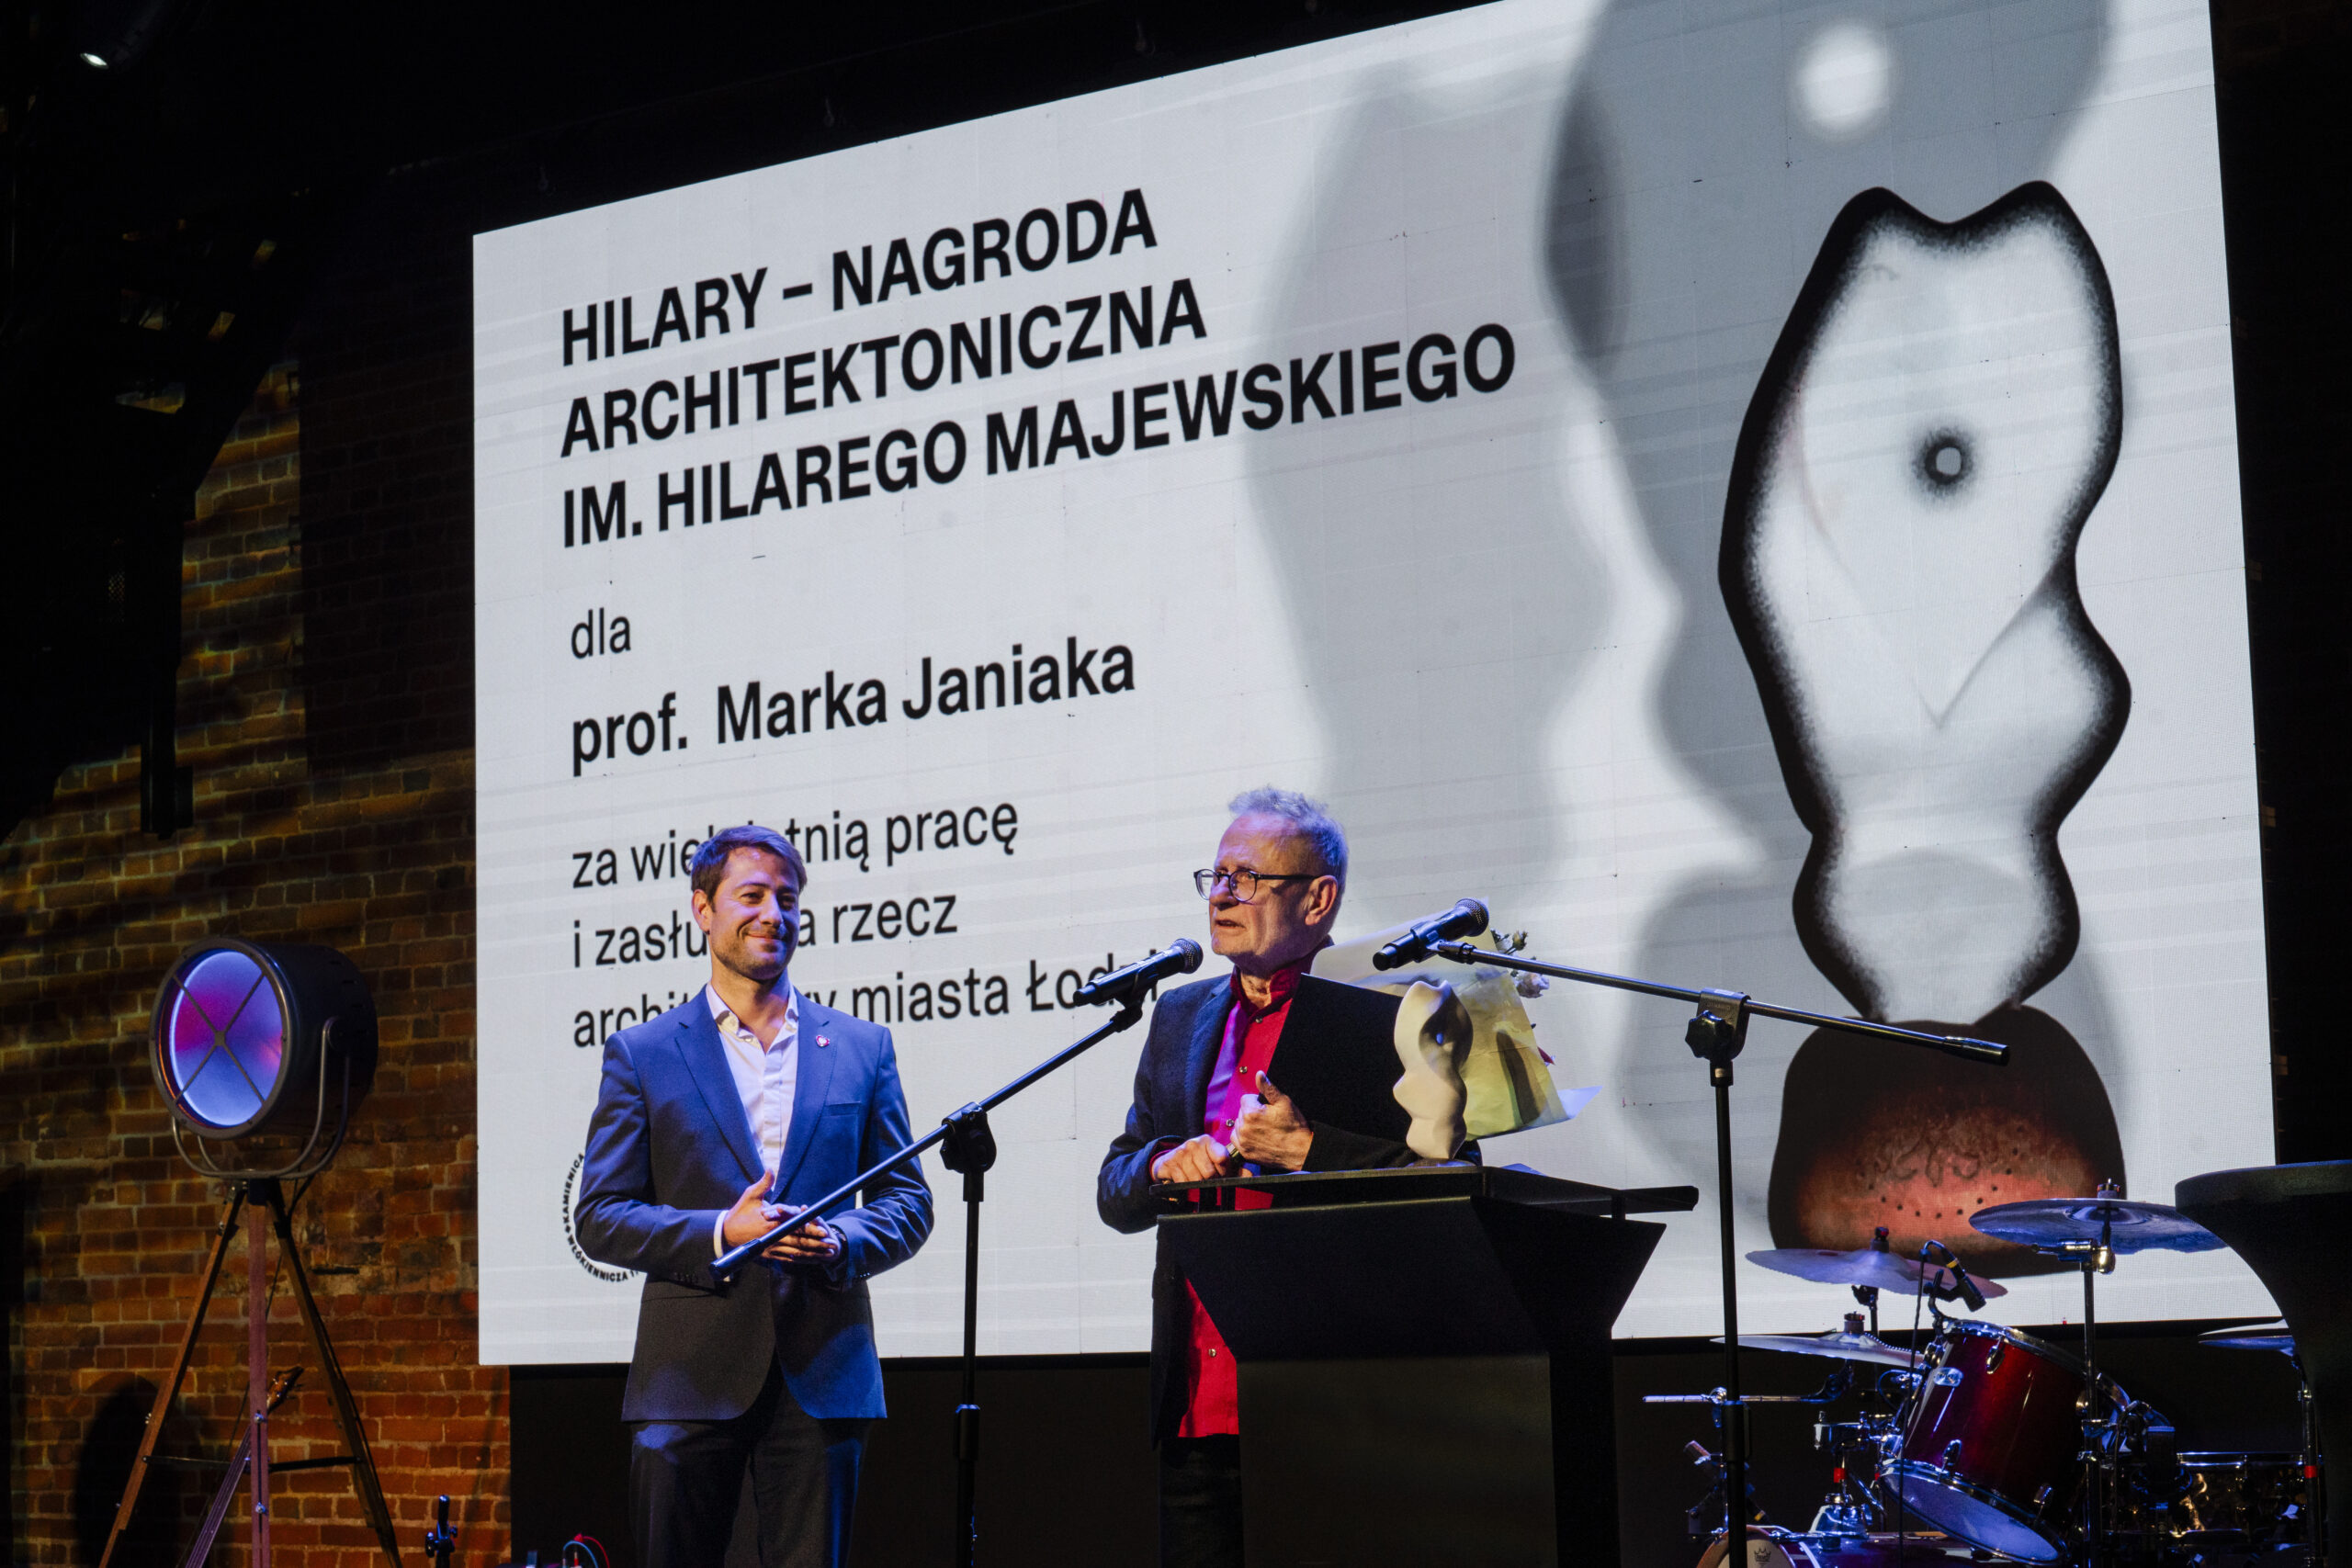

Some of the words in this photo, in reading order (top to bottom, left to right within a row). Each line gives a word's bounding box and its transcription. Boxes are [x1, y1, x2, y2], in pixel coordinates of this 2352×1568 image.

[562, 266, 768, 367] HILARY
[832, 187, 1158, 311] NAGRODA
[560, 277, 1207, 458] ARCHITEKTONICZNA
[564, 479, 642, 548] IM.
[658, 420, 967, 532] HILAREGO
[986, 322, 1516, 476] MAJEWSKIEGO
[571, 607, 632, 660] dla
[572, 692, 687, 778] prof.
[718, 670, 888, 744] Marka
[902, 636, 1136, 720] Janiaka
[572, 849, 618, 889] za
[886, 803, 1018, 867] pracę
[574, 919, 581, 968] i
[595, 909, 711, 966] zasłu
[832, 895, 957, 944] rzecz
[852, 968, 1010, 1023] miasta
[562, 1153, 584, 1224] KAMIENICA
